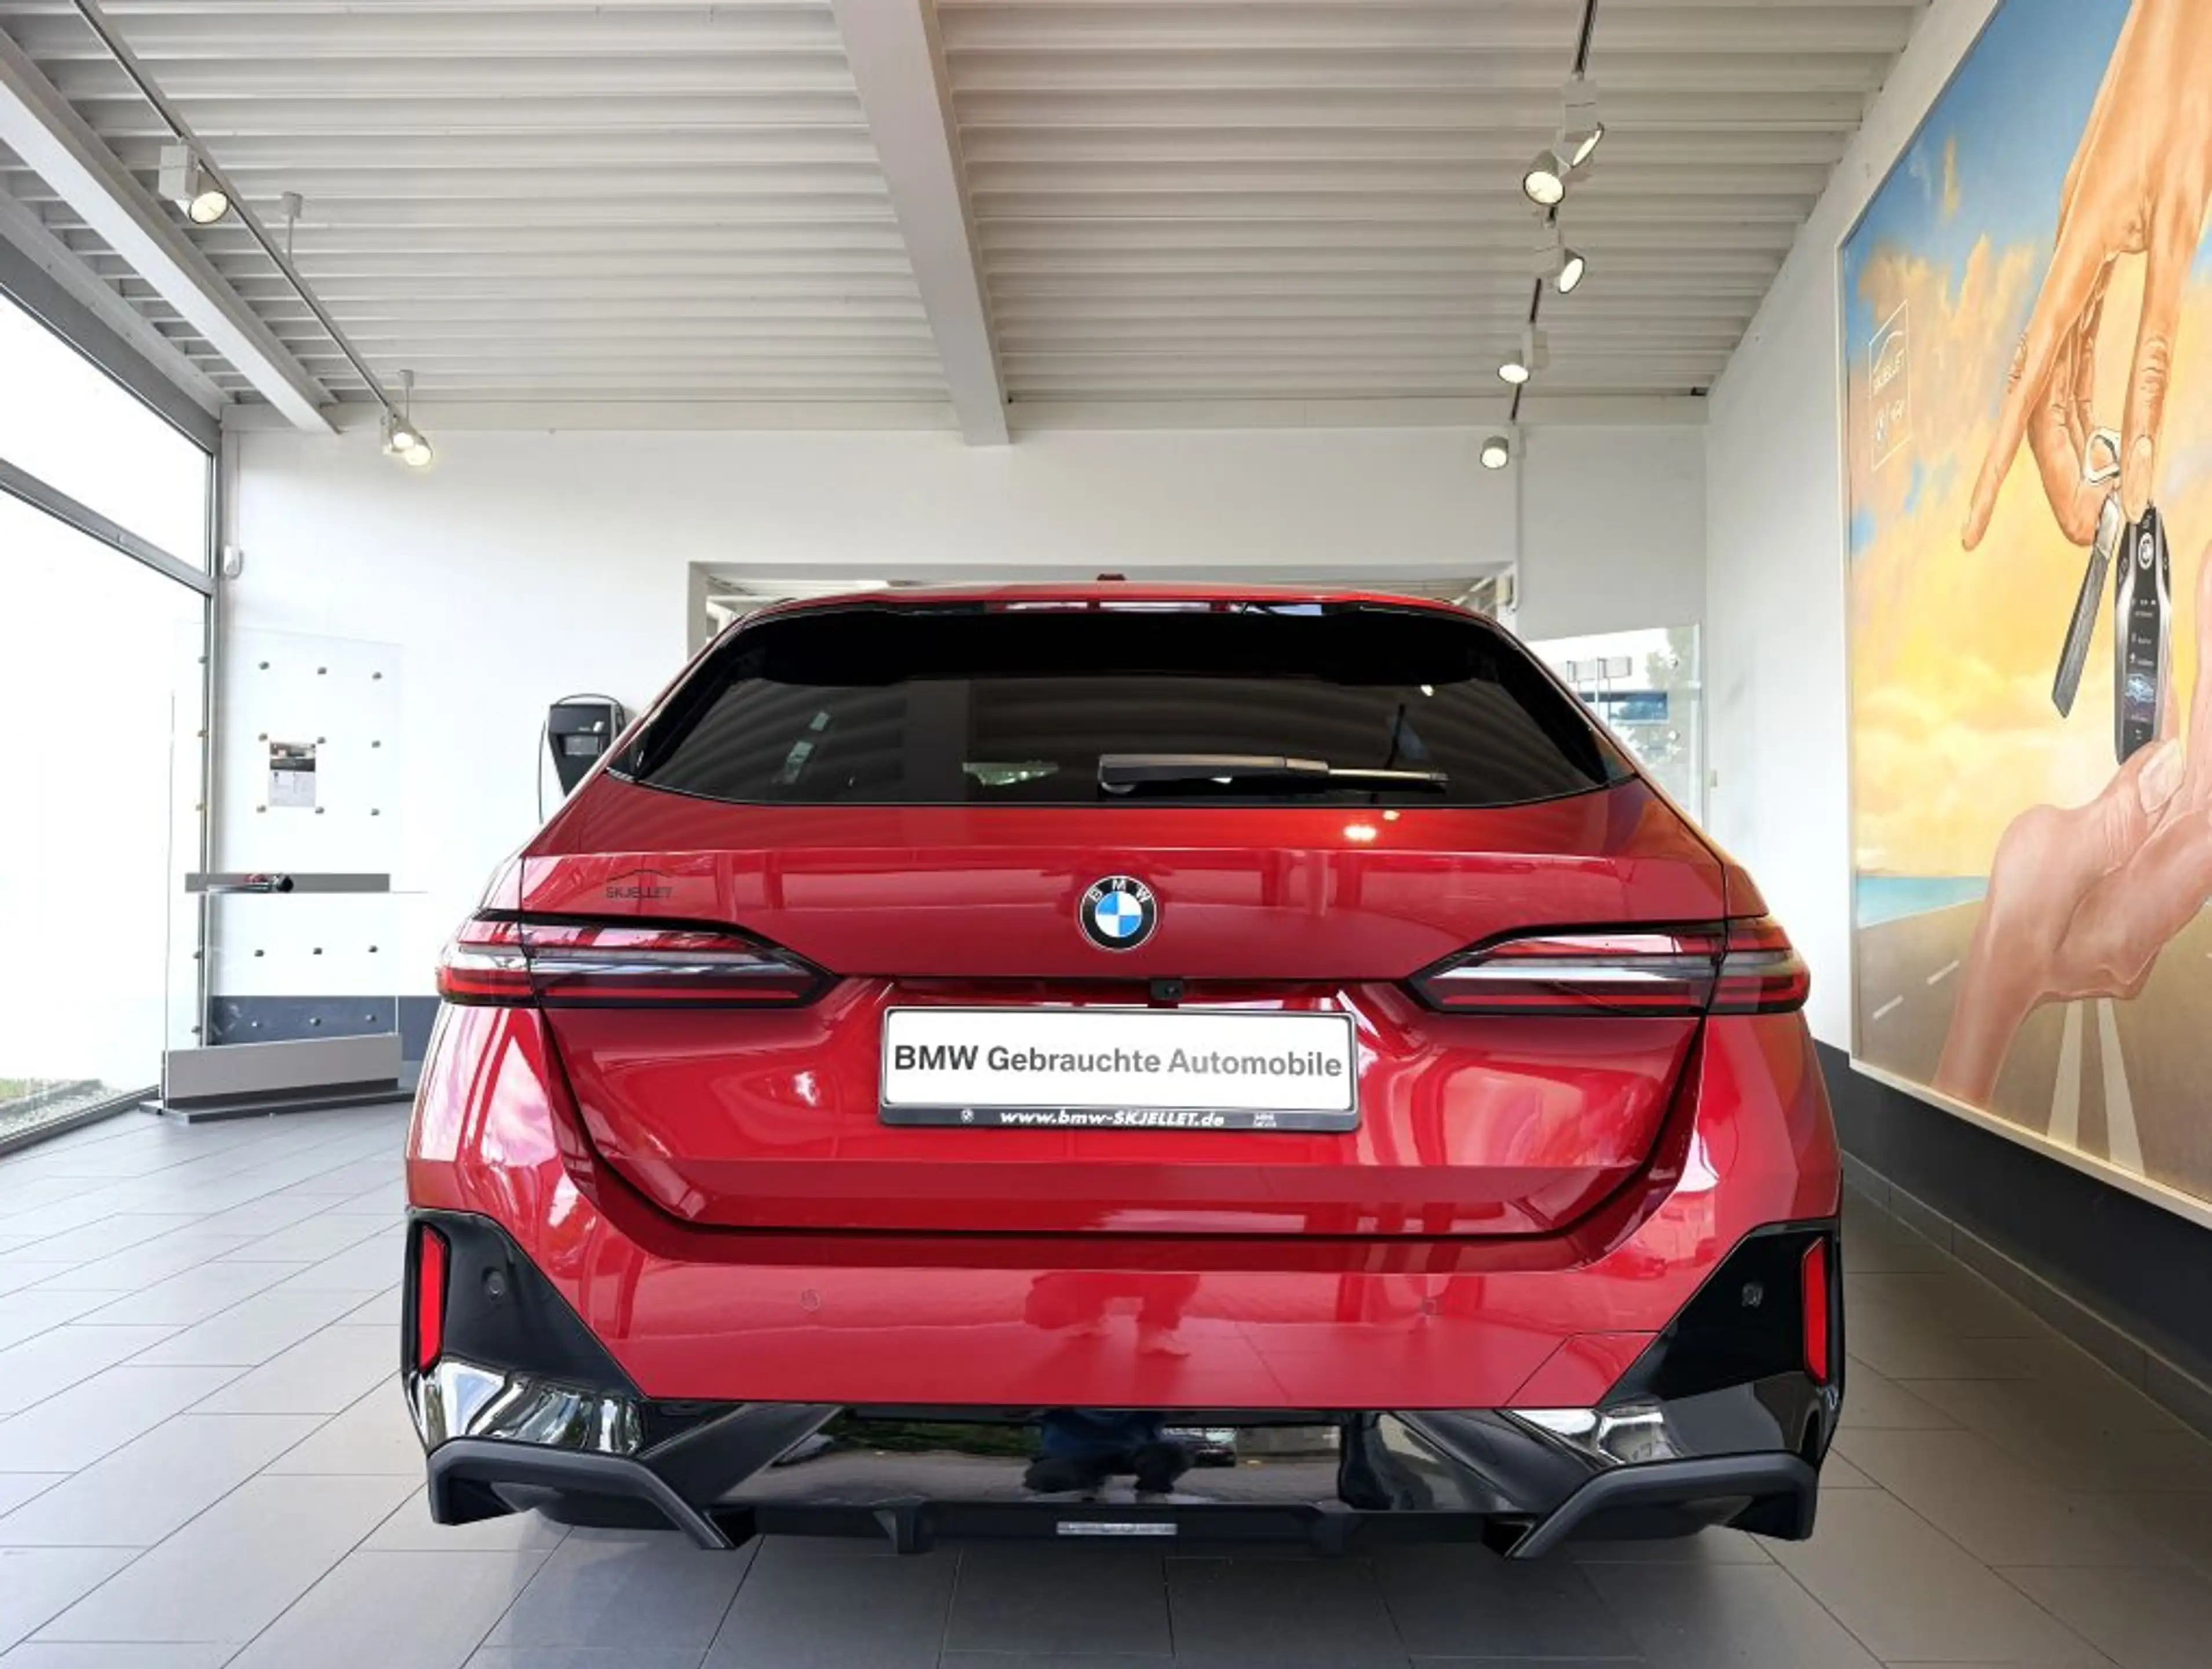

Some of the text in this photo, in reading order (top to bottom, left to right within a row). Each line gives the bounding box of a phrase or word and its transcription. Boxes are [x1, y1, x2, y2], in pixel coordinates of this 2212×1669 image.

[606, 887, 672, 898] SKJELLET
[1088, 879, 1151, 903] BMW
[894, 1044, 1342, 1076] BMW Gebrauchte Automobile
[1000, 1108, 1225, 1127] www.bmw-SKJELLET.de
